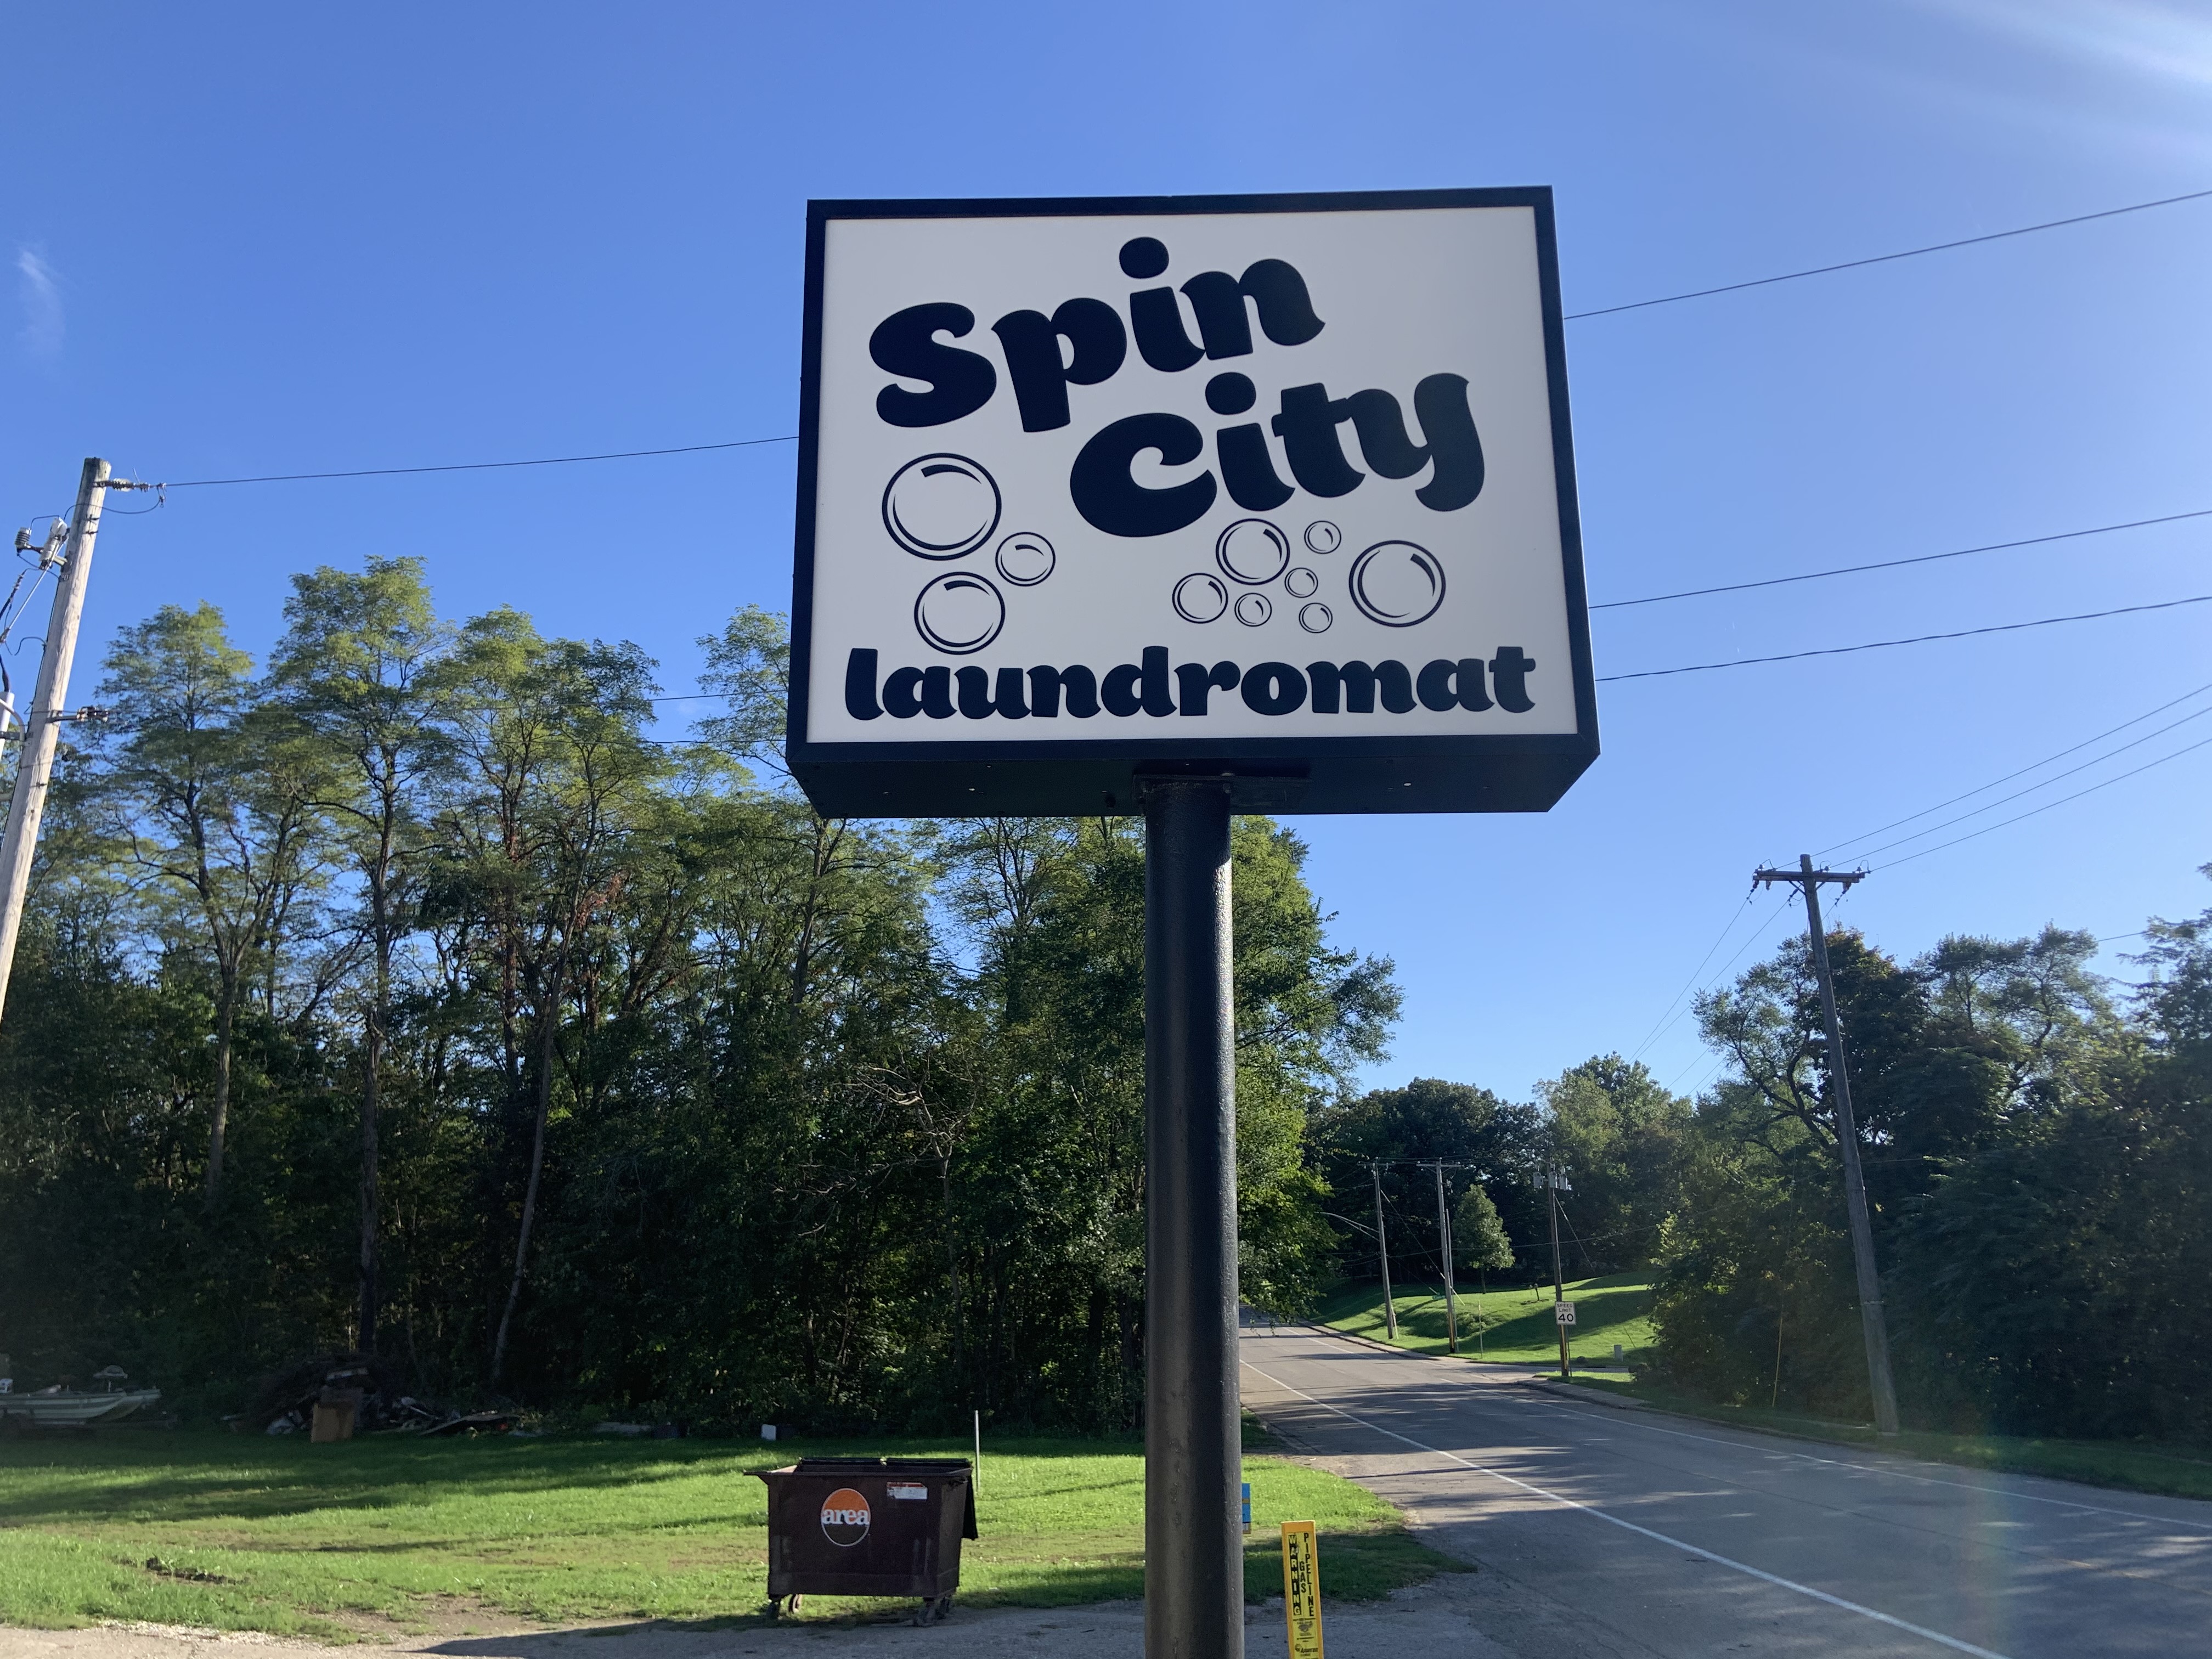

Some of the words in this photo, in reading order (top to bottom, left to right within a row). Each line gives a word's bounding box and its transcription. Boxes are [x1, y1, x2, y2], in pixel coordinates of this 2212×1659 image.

[868, 237, 1326, 432] Spin
[1070, 372, 1485, 538] City
[845, 646, 1535, 721] laundromat
[1558, 1313, 1574, 1322] 40
[823, 1509, 869, 1525] area
[1289, 1535, 1301, 1615] WARNING
[1304, 1532, 1314, 1616] PIPELINE
